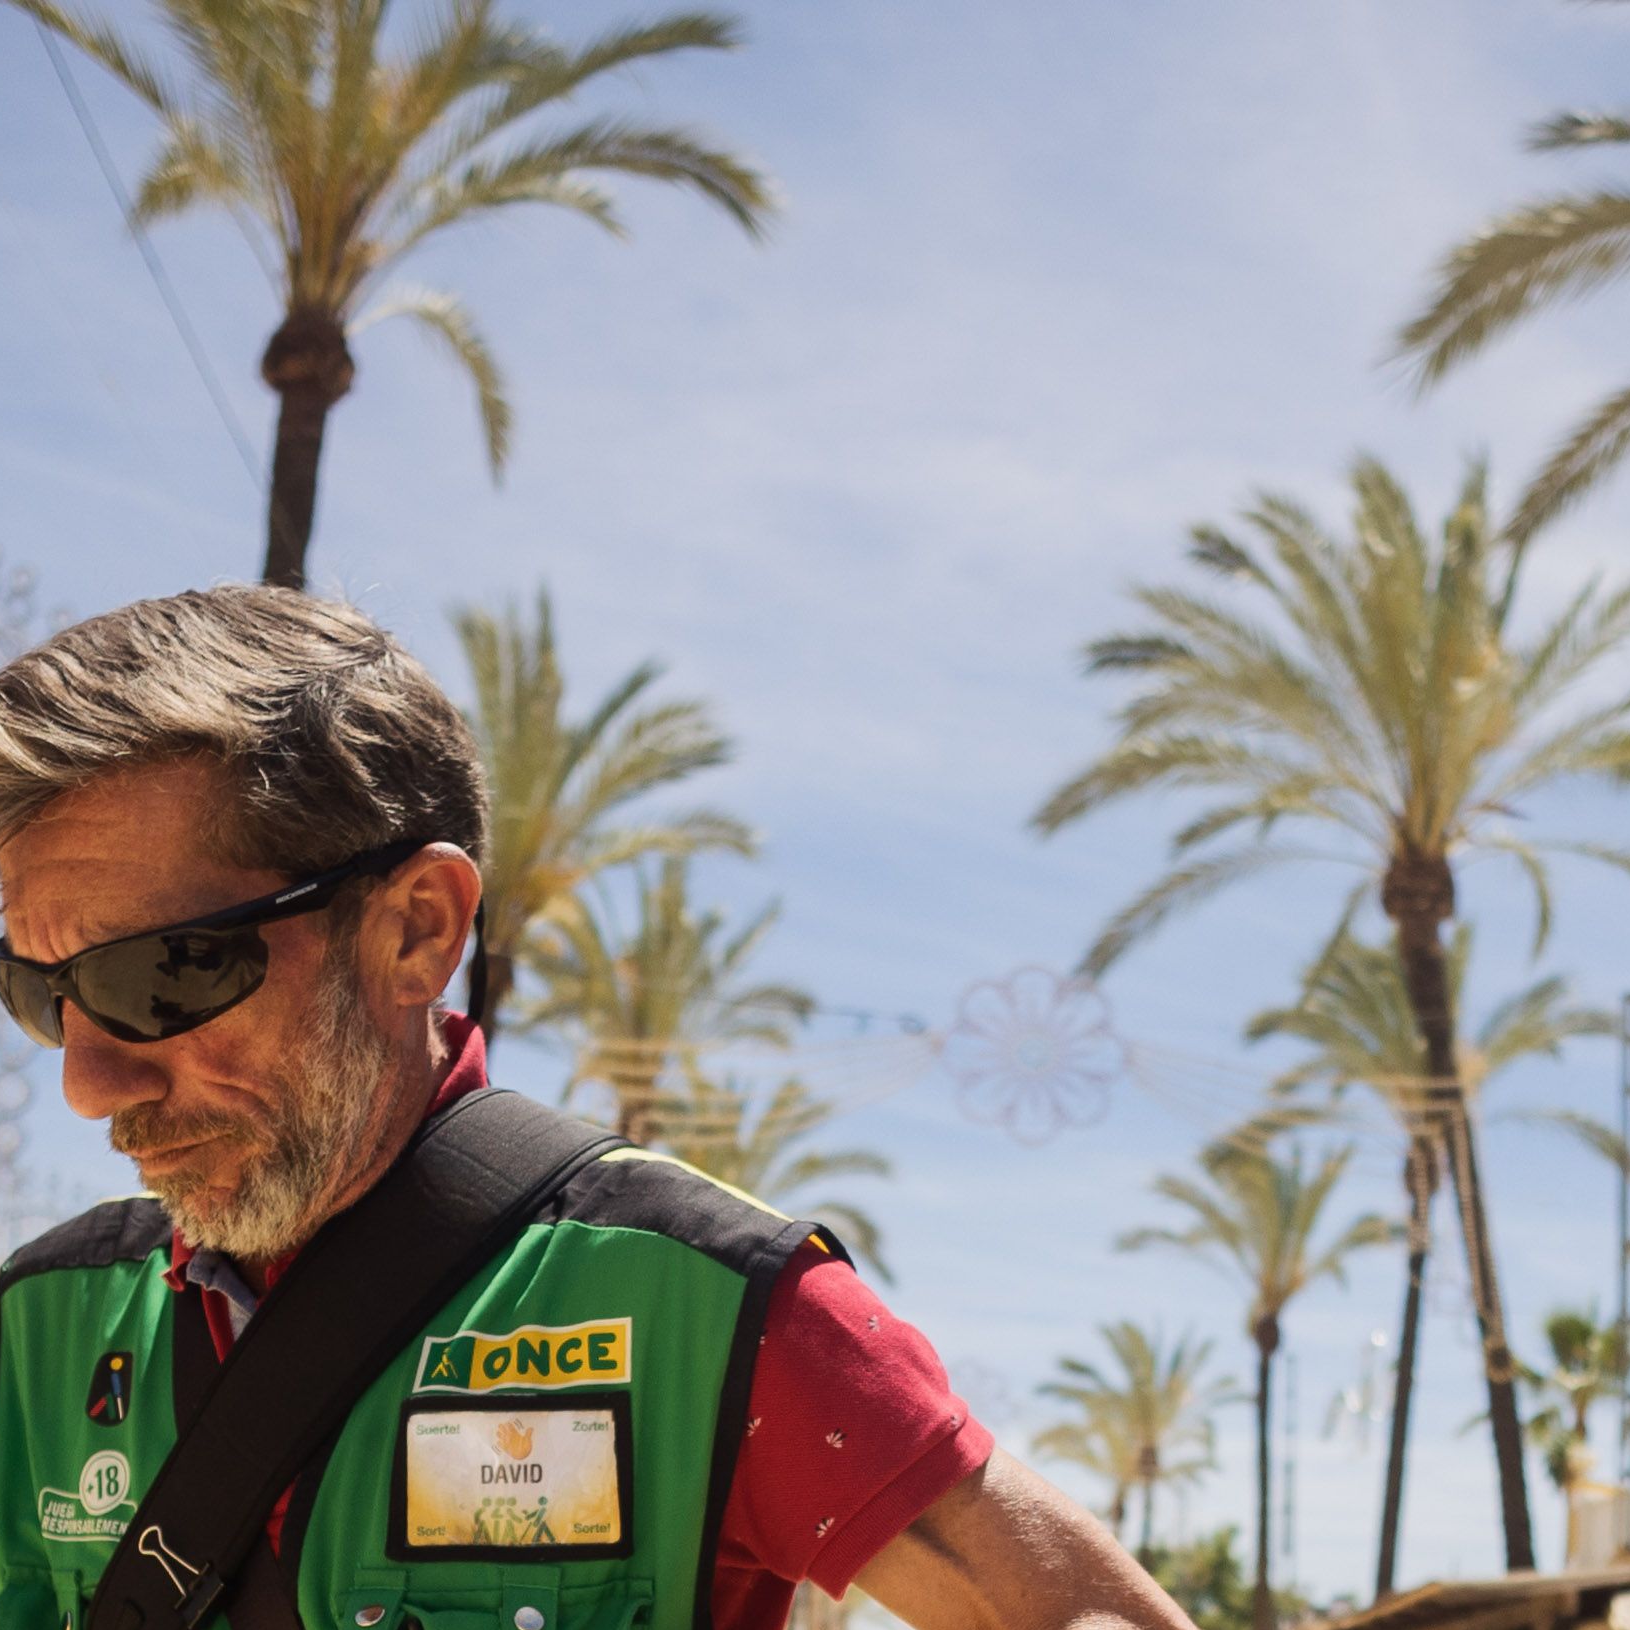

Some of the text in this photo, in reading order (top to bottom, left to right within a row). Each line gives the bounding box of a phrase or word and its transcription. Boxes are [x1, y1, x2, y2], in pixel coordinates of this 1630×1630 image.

[482, 1332, 617, 1380] ONCE
[416, 1423, 461, 1435] Suerte!
[572, 1421, 610, 1432] Zorte!
[481, 1463, 543, 1484] DAVID
[87, 1465, 120, 1500] +18
[417, 1525, 446, 1537] Sort!
[574, 1523, 611, 1534] Sorte!
